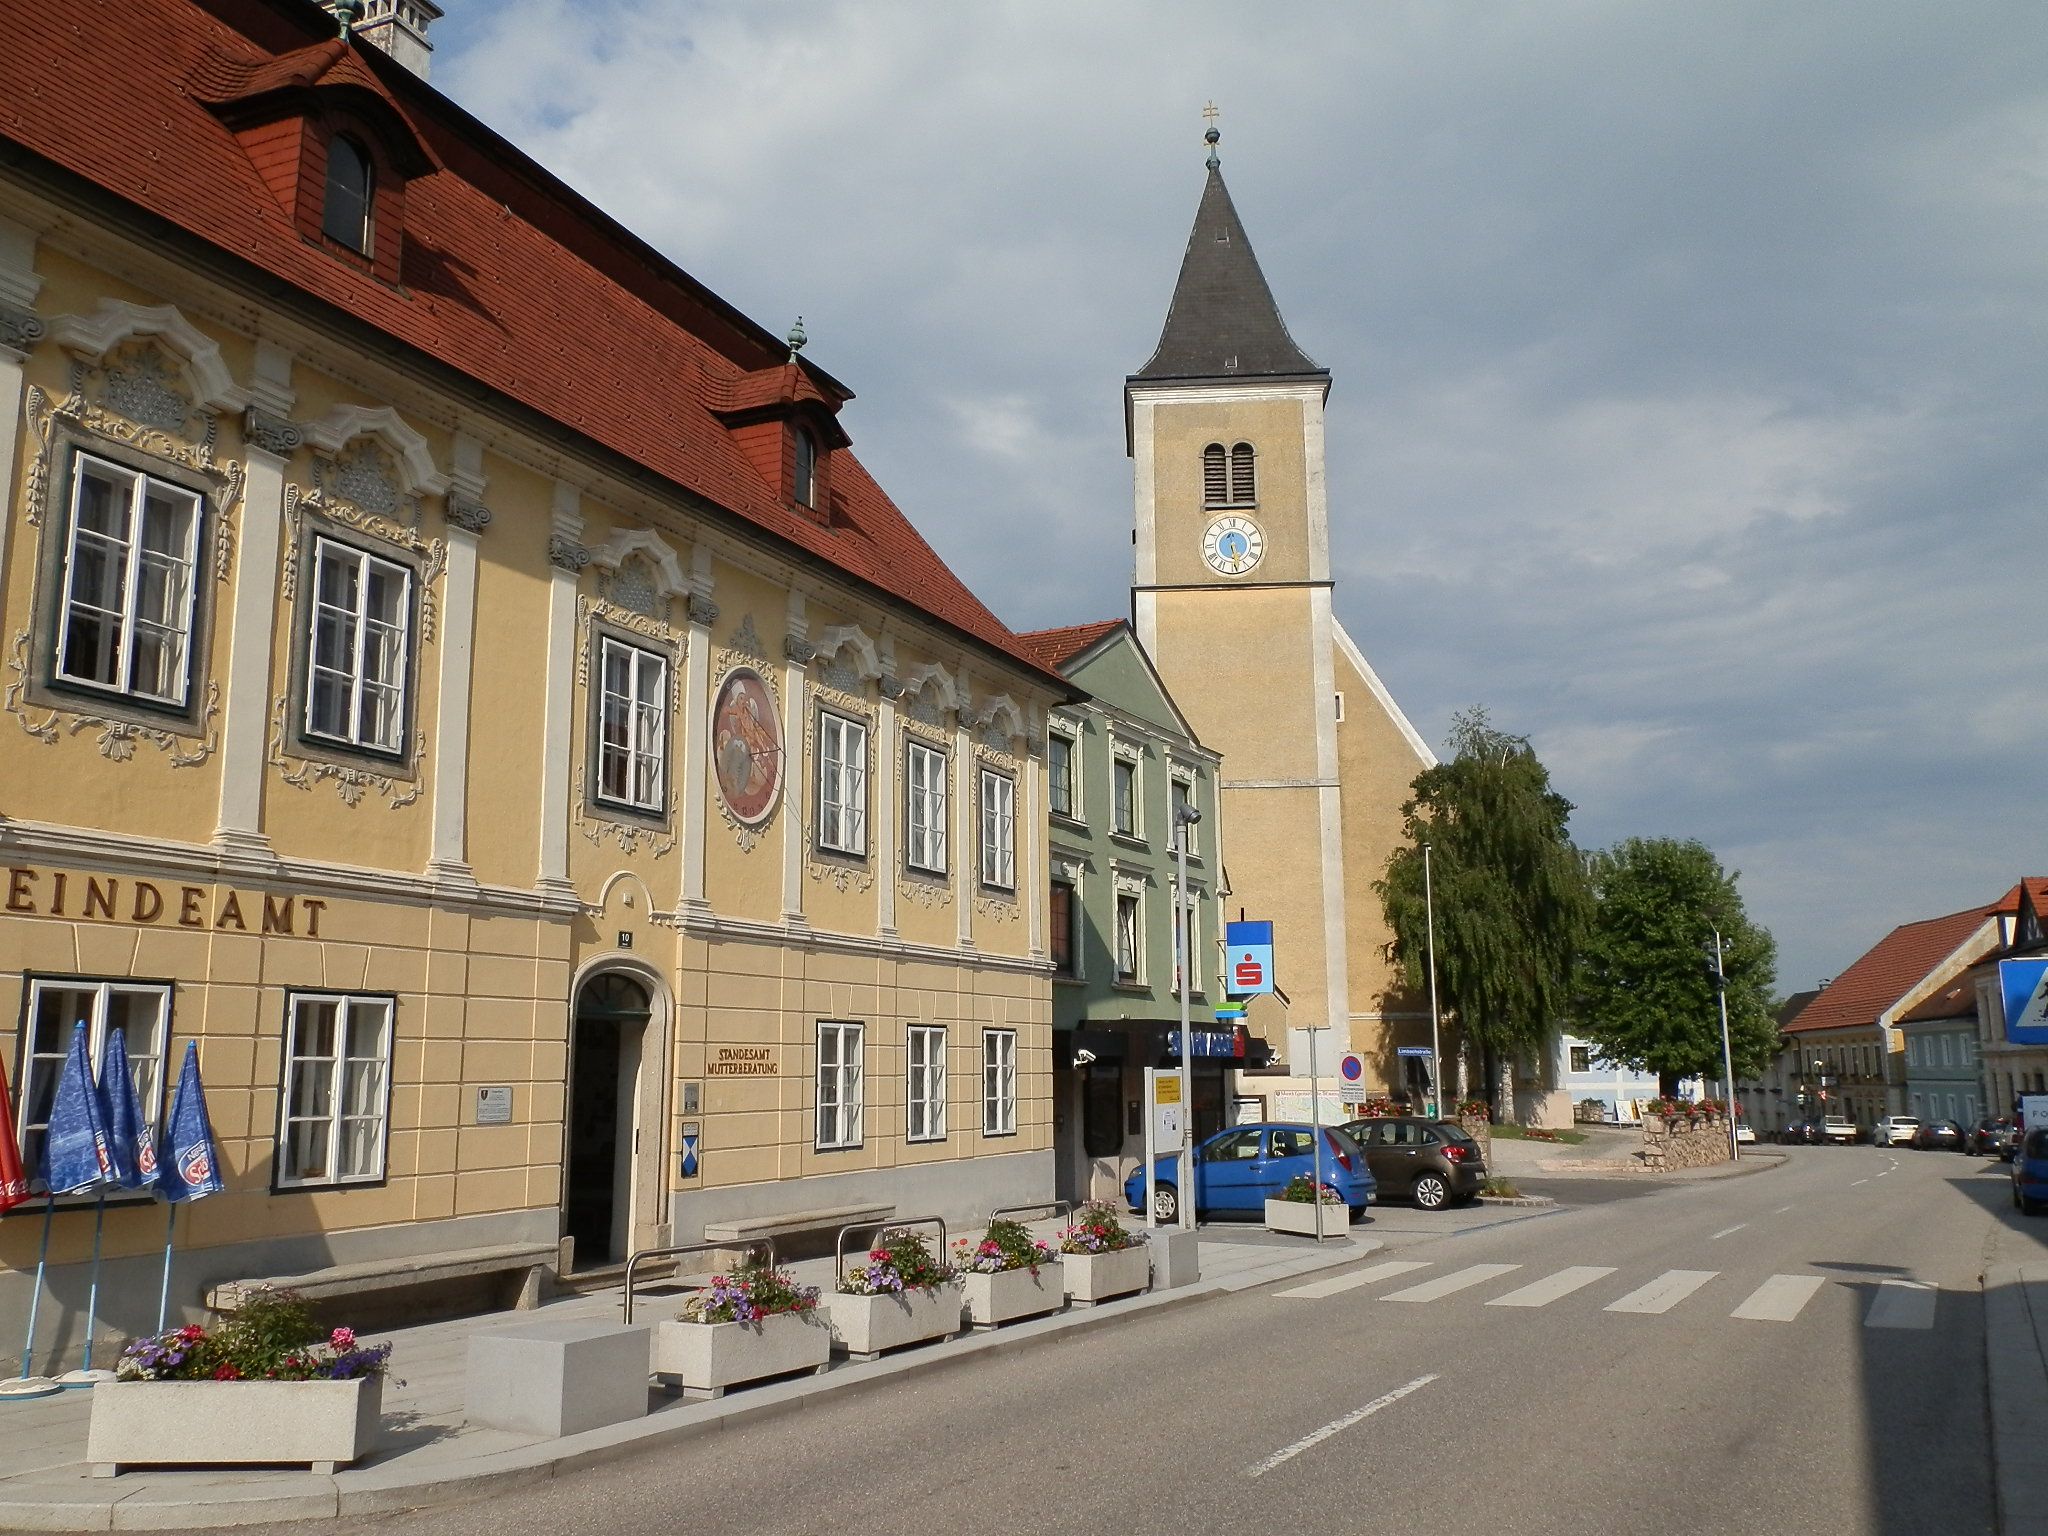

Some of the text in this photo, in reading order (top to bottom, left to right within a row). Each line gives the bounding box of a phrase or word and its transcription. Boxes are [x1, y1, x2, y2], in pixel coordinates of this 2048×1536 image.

[6, 868, 328, 937] EINDEAMT
[621, 933, 630, 942] 10
[718, 1048, 770, 1061] STANDESAMT
[707, 1062, 778, 1075] MUTTERBERATUNG
